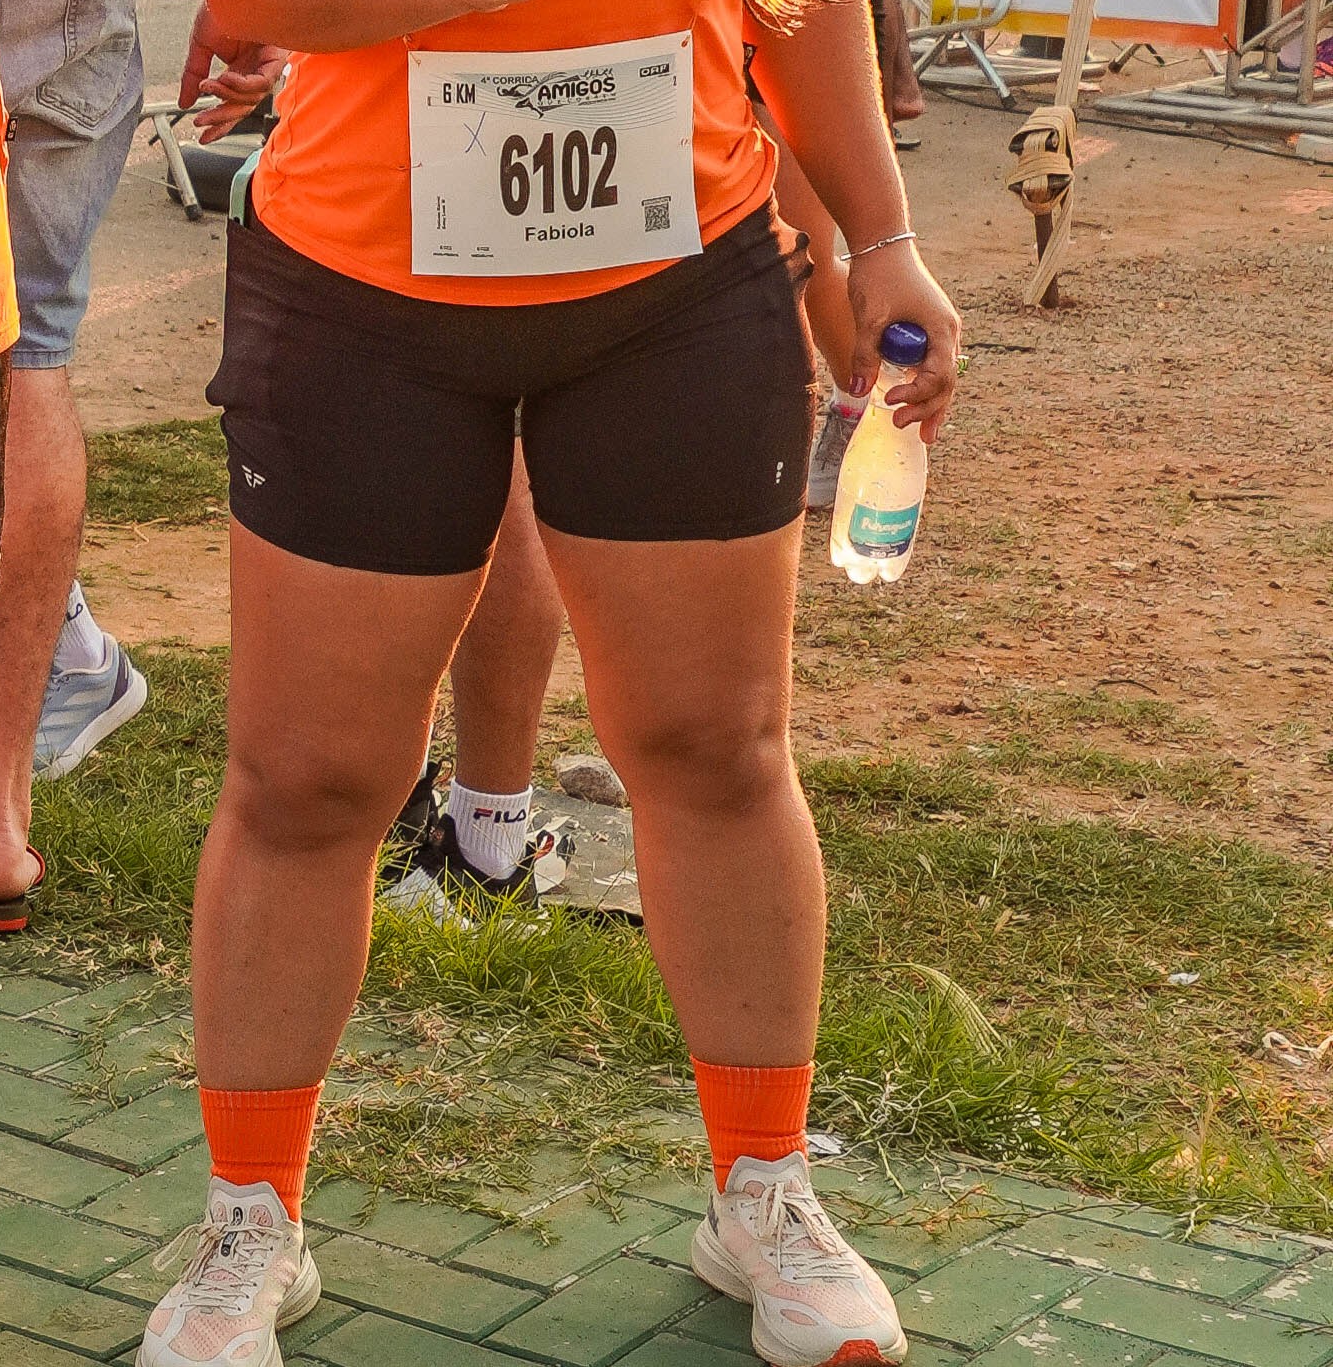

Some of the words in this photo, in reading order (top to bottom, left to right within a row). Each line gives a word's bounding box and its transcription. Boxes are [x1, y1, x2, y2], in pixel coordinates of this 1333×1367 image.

[442, 83, 452, 104] 6
[456, 83, 476, 105] KM
[537, 76, 616, 102] AMIGOS
[499, 126, 619, 217] 6102
[524, 222, 596, 242] Fabiola
[472, 807, 527, 824] FILA
